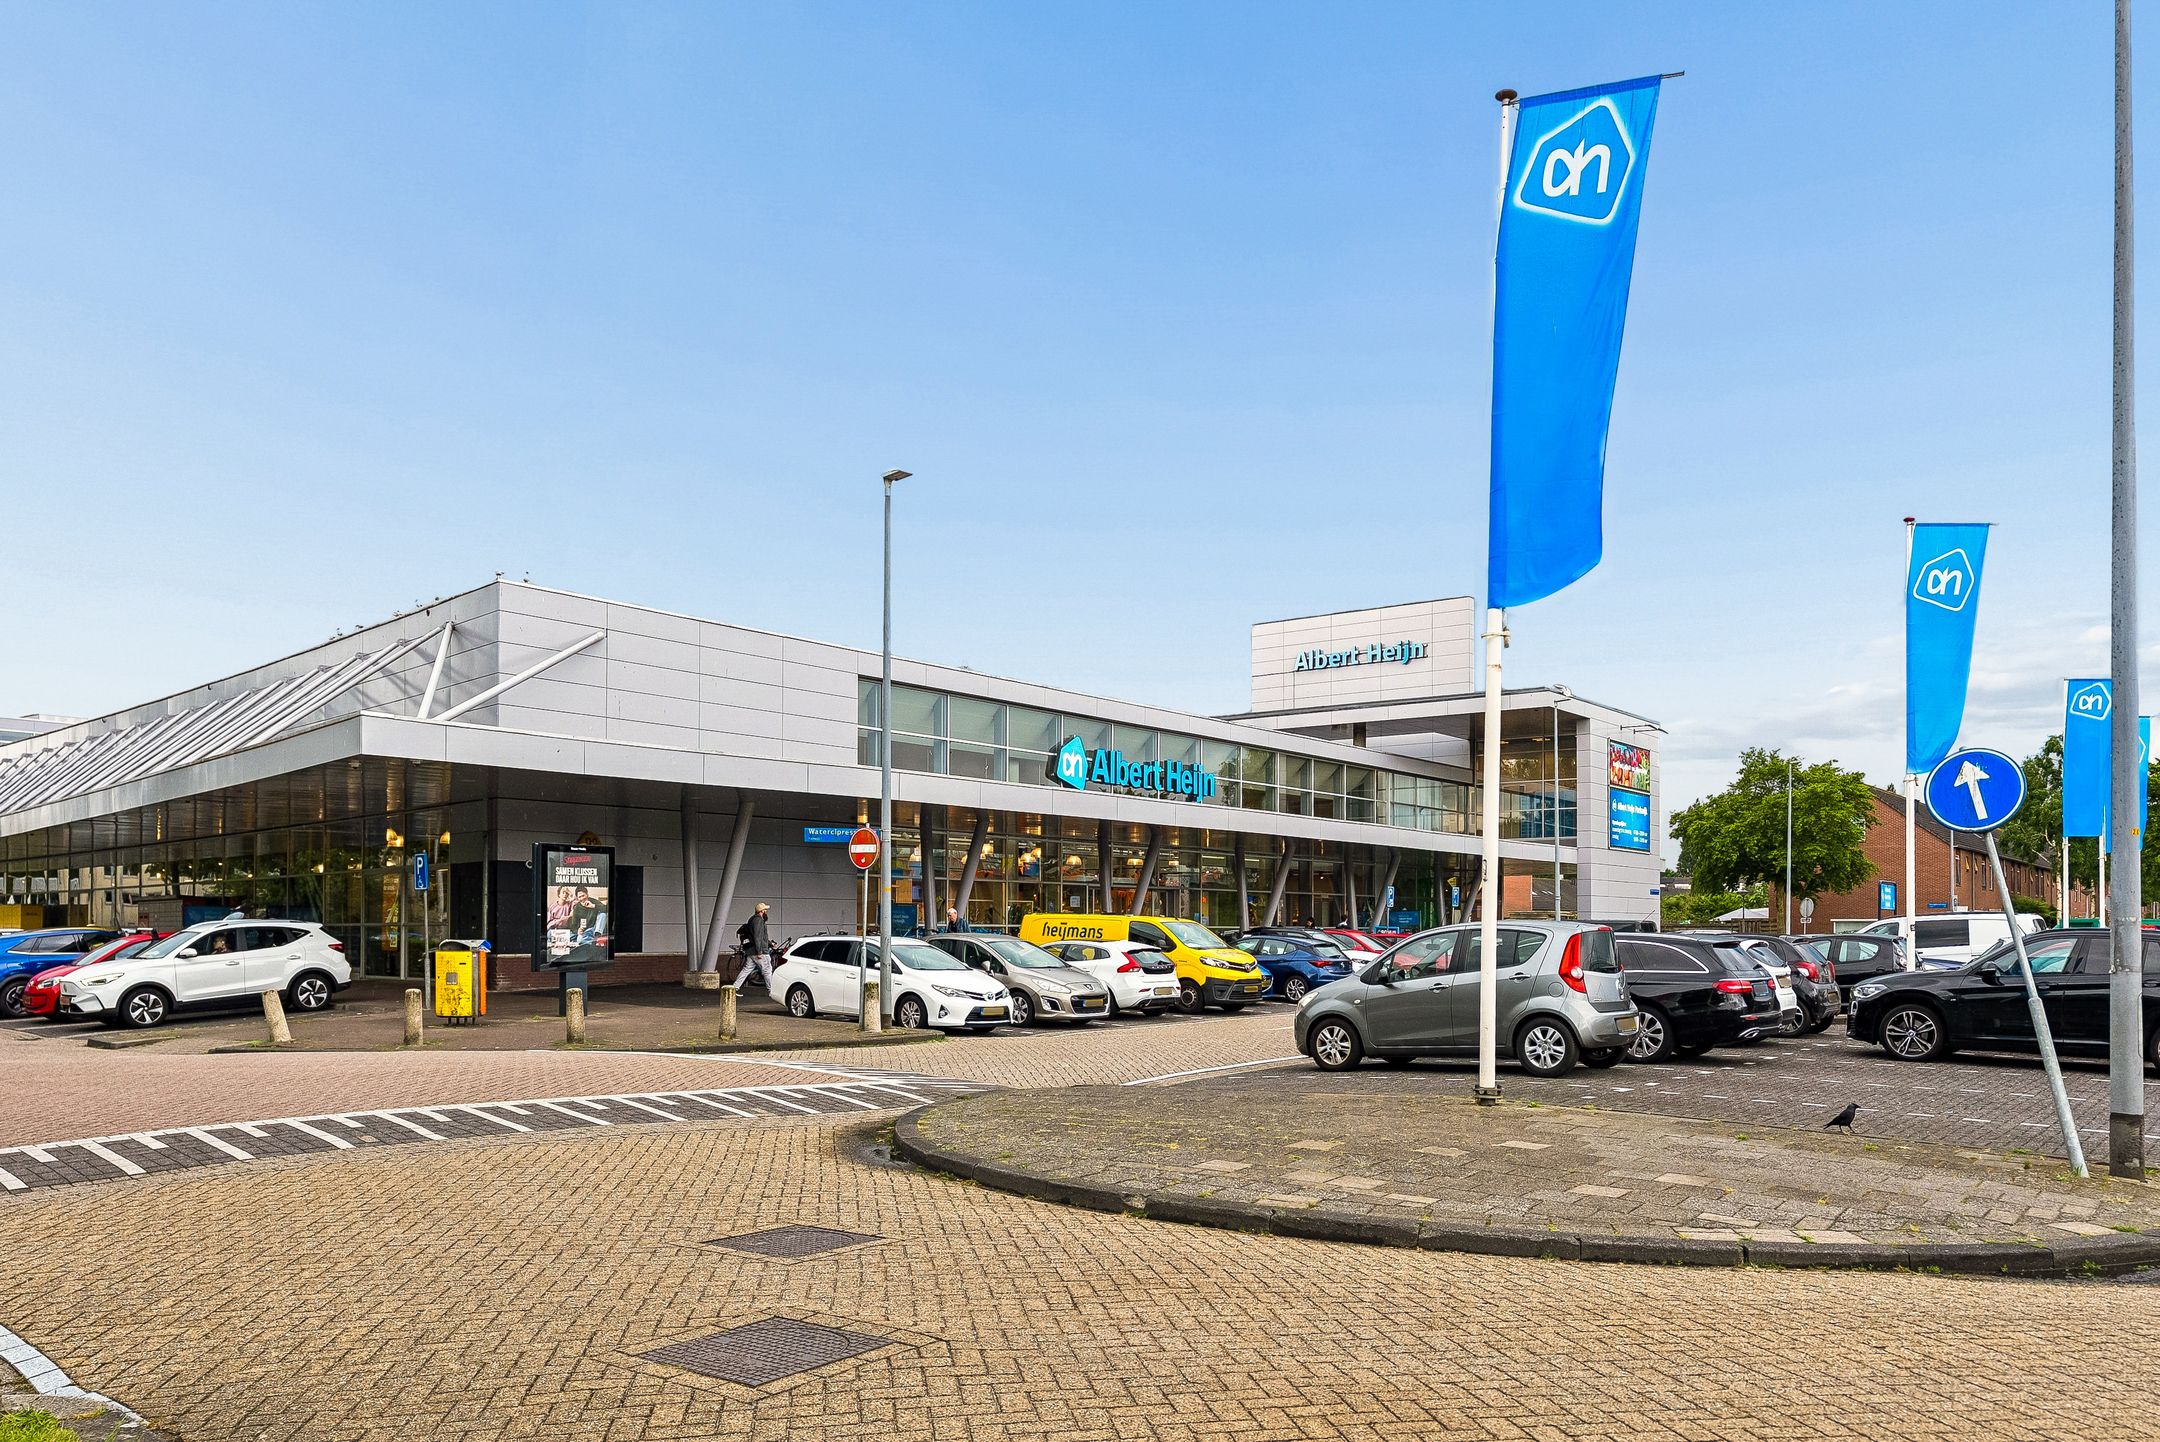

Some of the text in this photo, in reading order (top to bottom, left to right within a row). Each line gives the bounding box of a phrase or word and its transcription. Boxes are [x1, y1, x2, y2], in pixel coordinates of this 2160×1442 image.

[1294, 640, 1425, 672] Albert Heijn
[1091, 748, 1216, 803] Albert Heijn
[555, 866, 575, 876] SAMEN
[555, 875, 570, 884] DAAR
[581, 876, 588, 884] IK
[588, 876, 599, 884] VAN
[1042, 922, 1104, 941] heijmans
